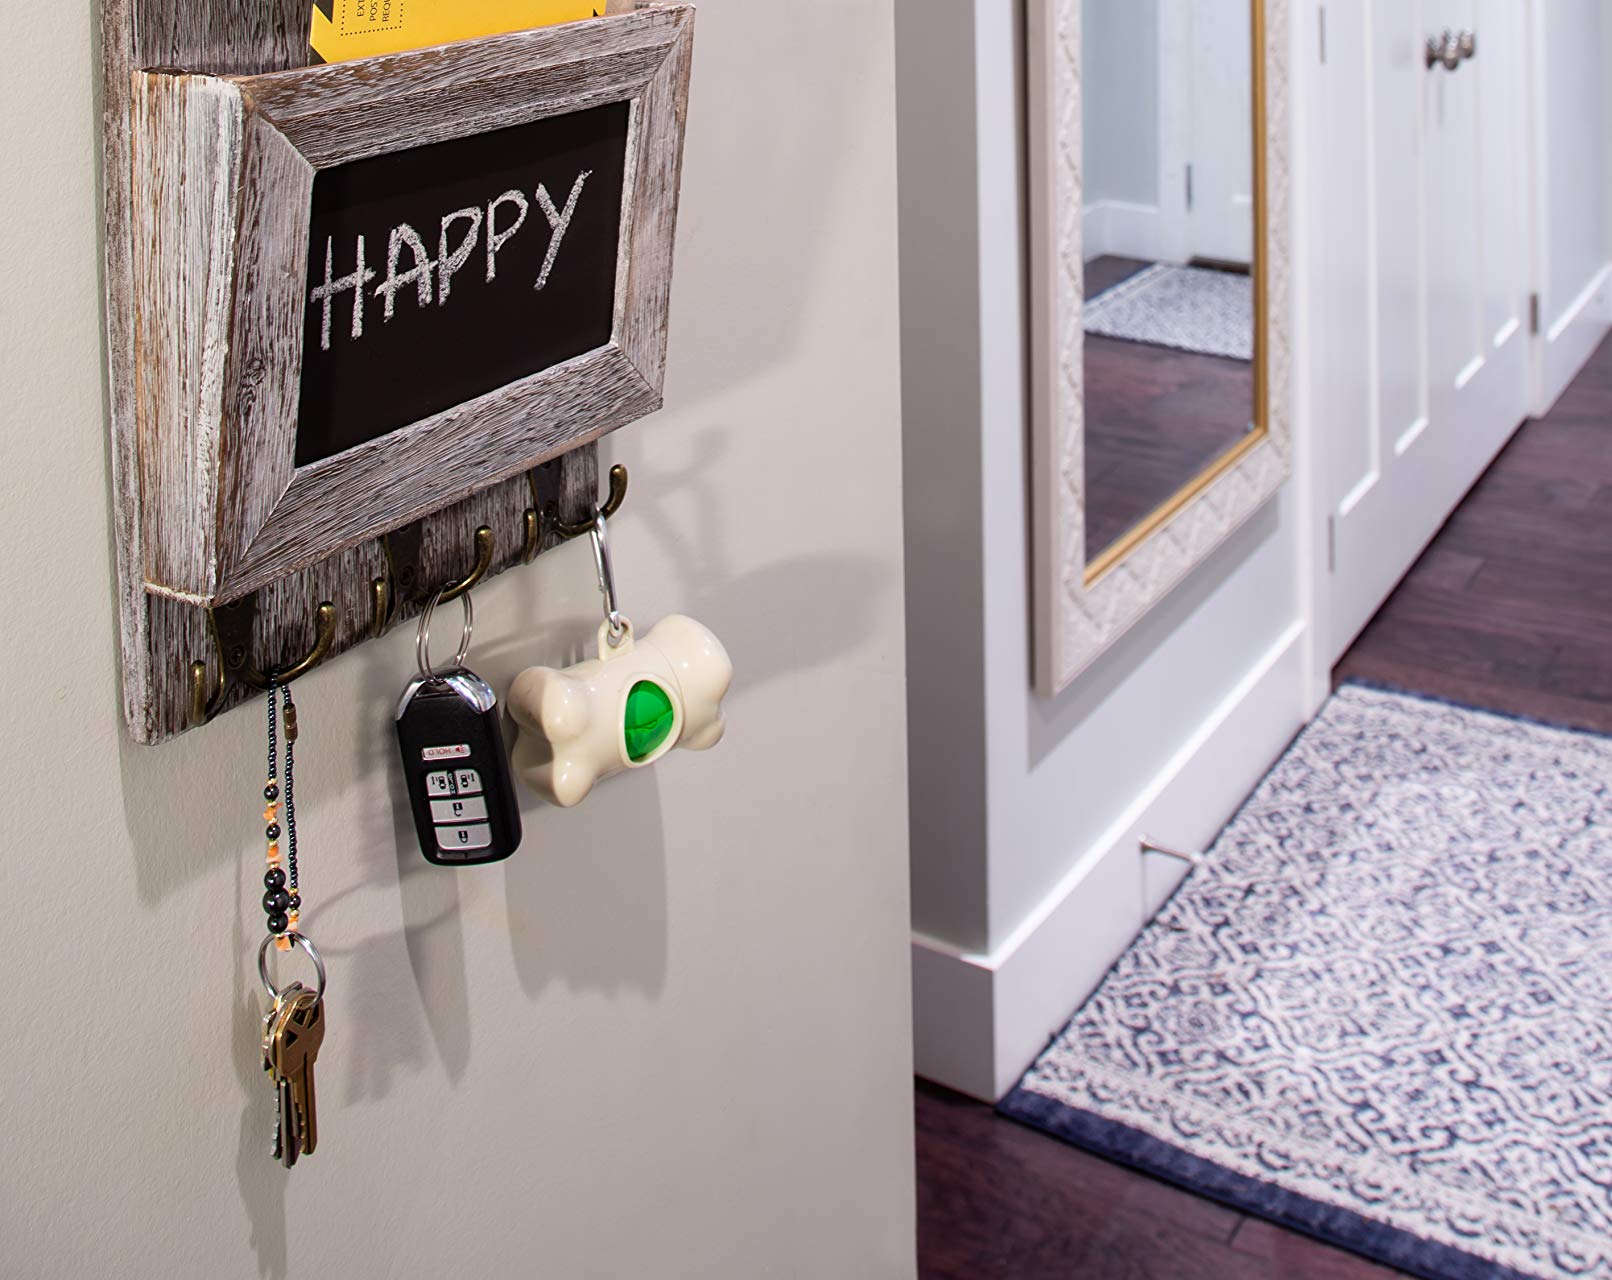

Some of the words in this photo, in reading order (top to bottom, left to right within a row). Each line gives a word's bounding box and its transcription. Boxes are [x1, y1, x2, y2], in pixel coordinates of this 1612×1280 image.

[311, 170, 592, 351] HAPPY
[428, 748, 452, 756] HOLD
[447, 773, 456, 795] HOLD
